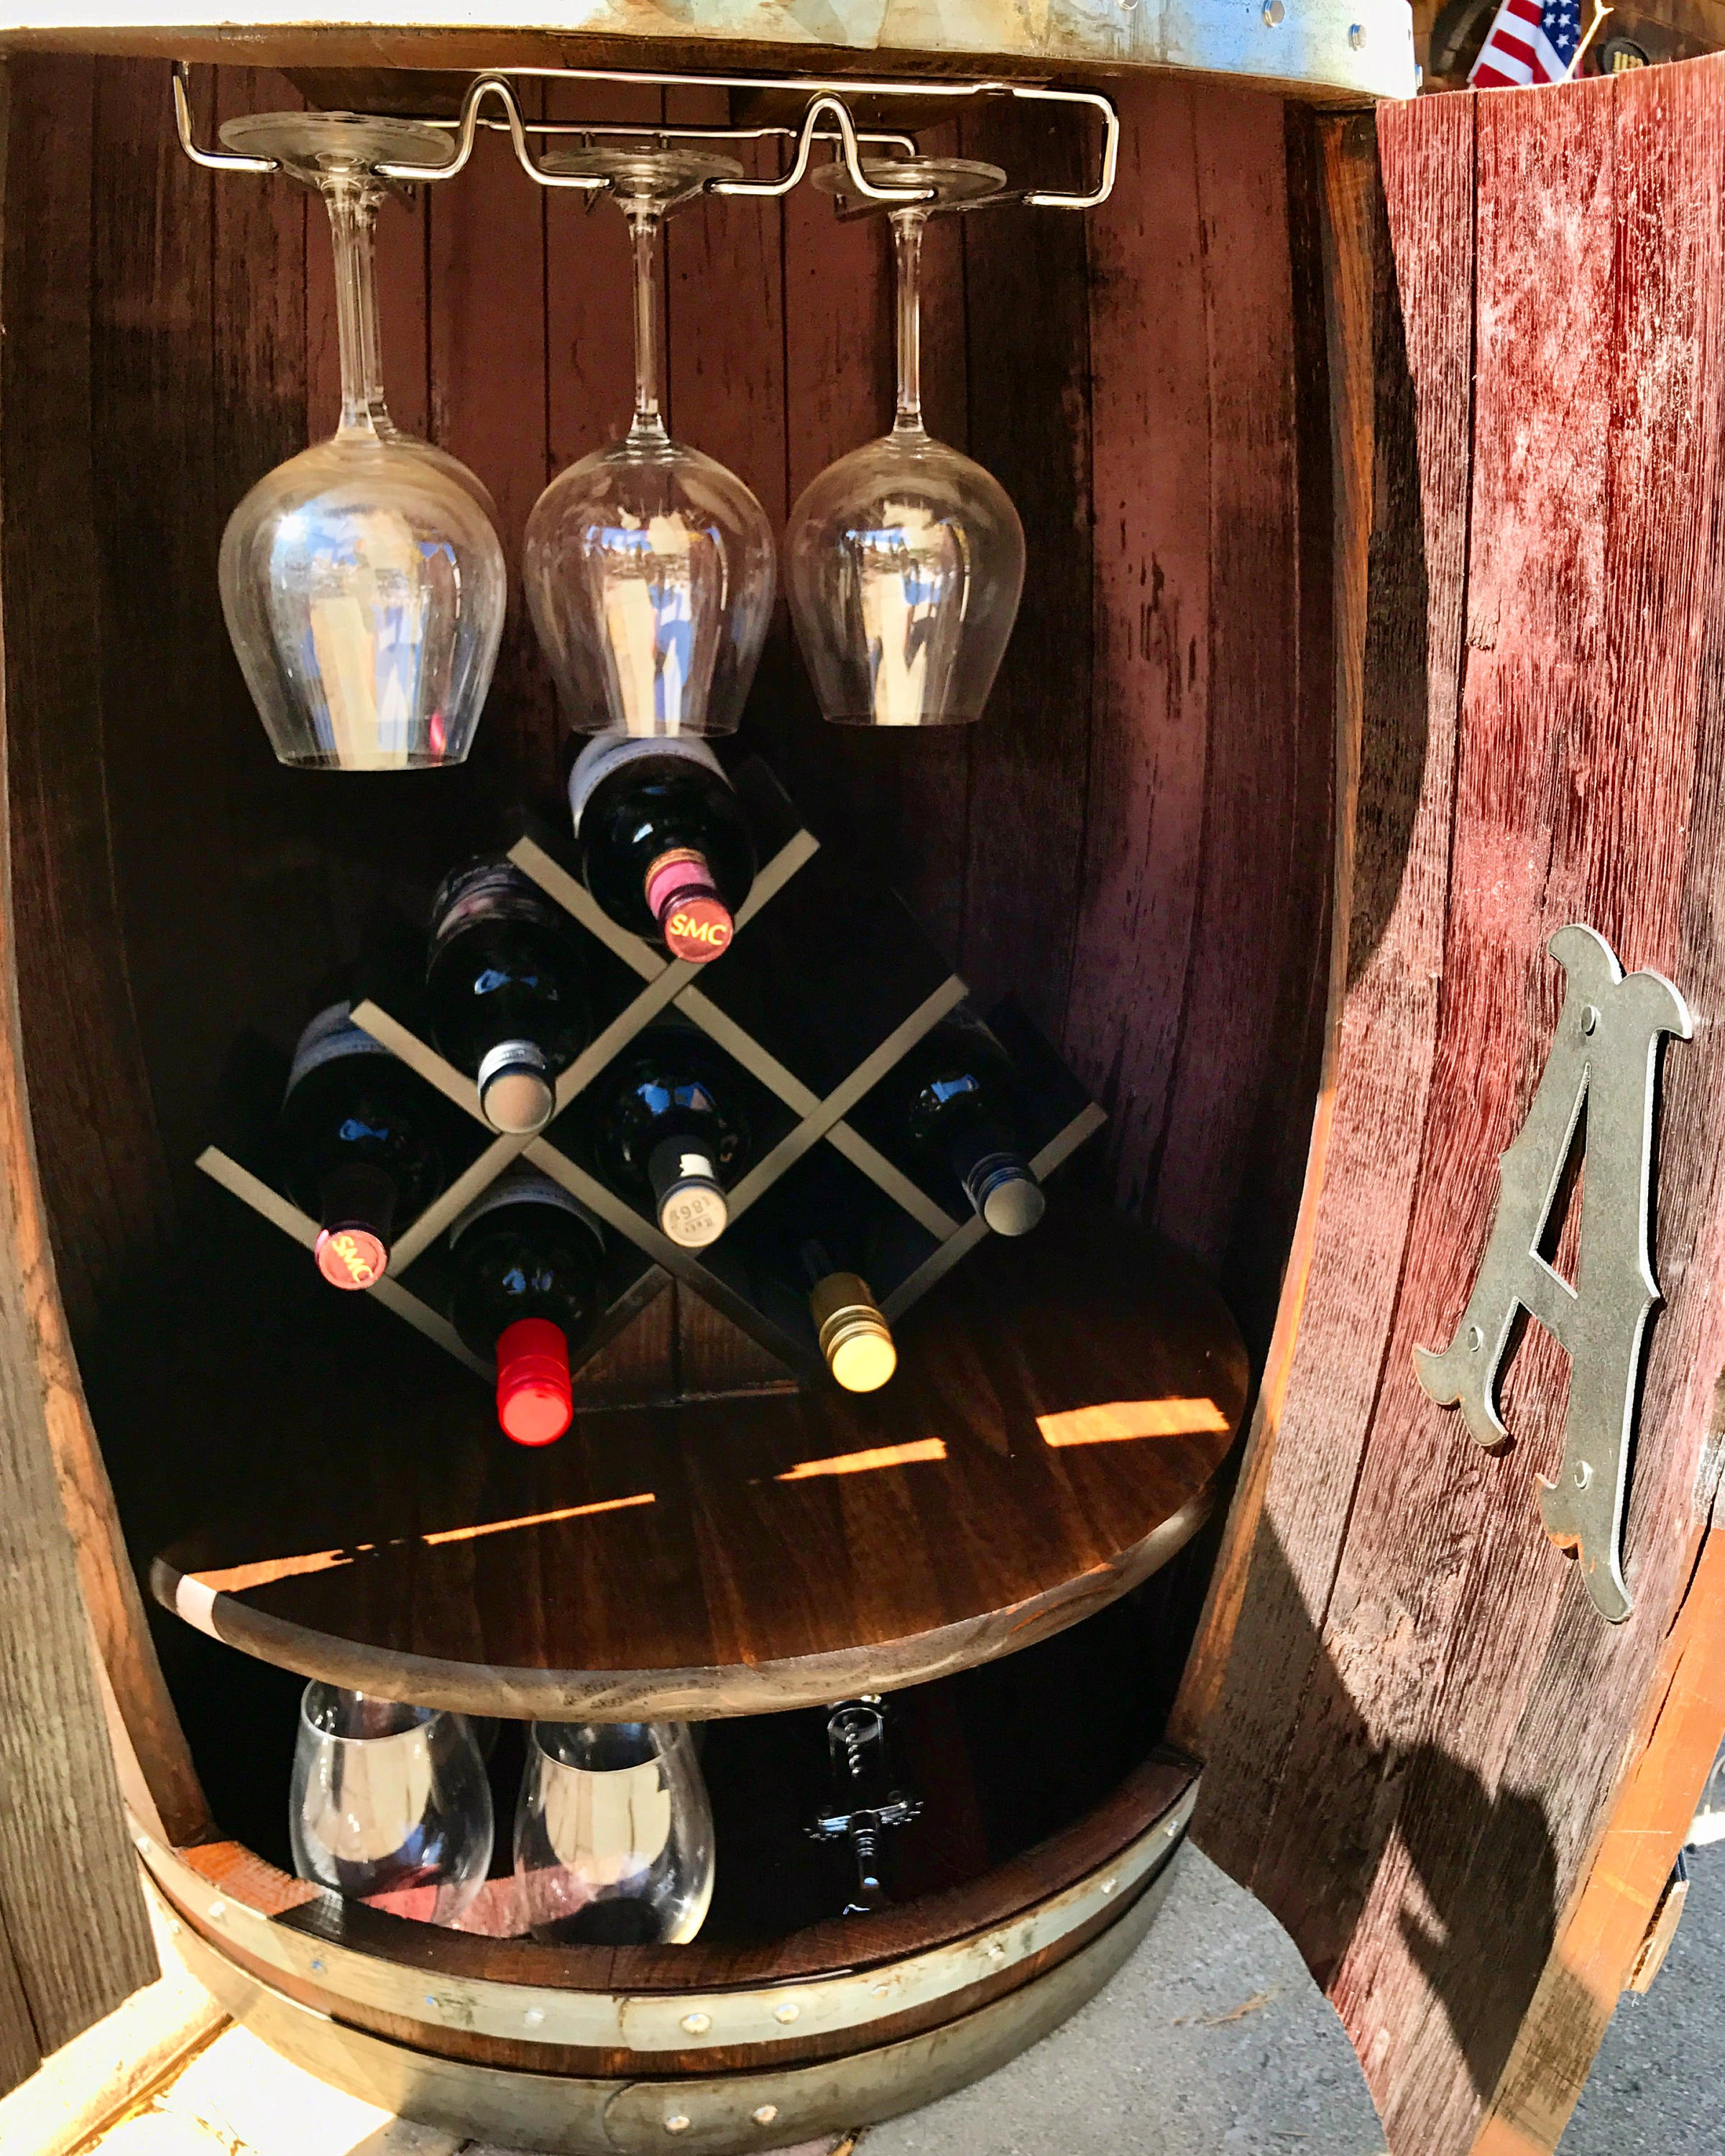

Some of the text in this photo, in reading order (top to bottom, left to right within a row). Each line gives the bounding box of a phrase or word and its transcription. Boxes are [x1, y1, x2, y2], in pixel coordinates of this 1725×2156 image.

[670, 913, 727, 946] SMC
[331, 1235, 374, 1283] SMC
[1412, 923, 1692, 1624] A
